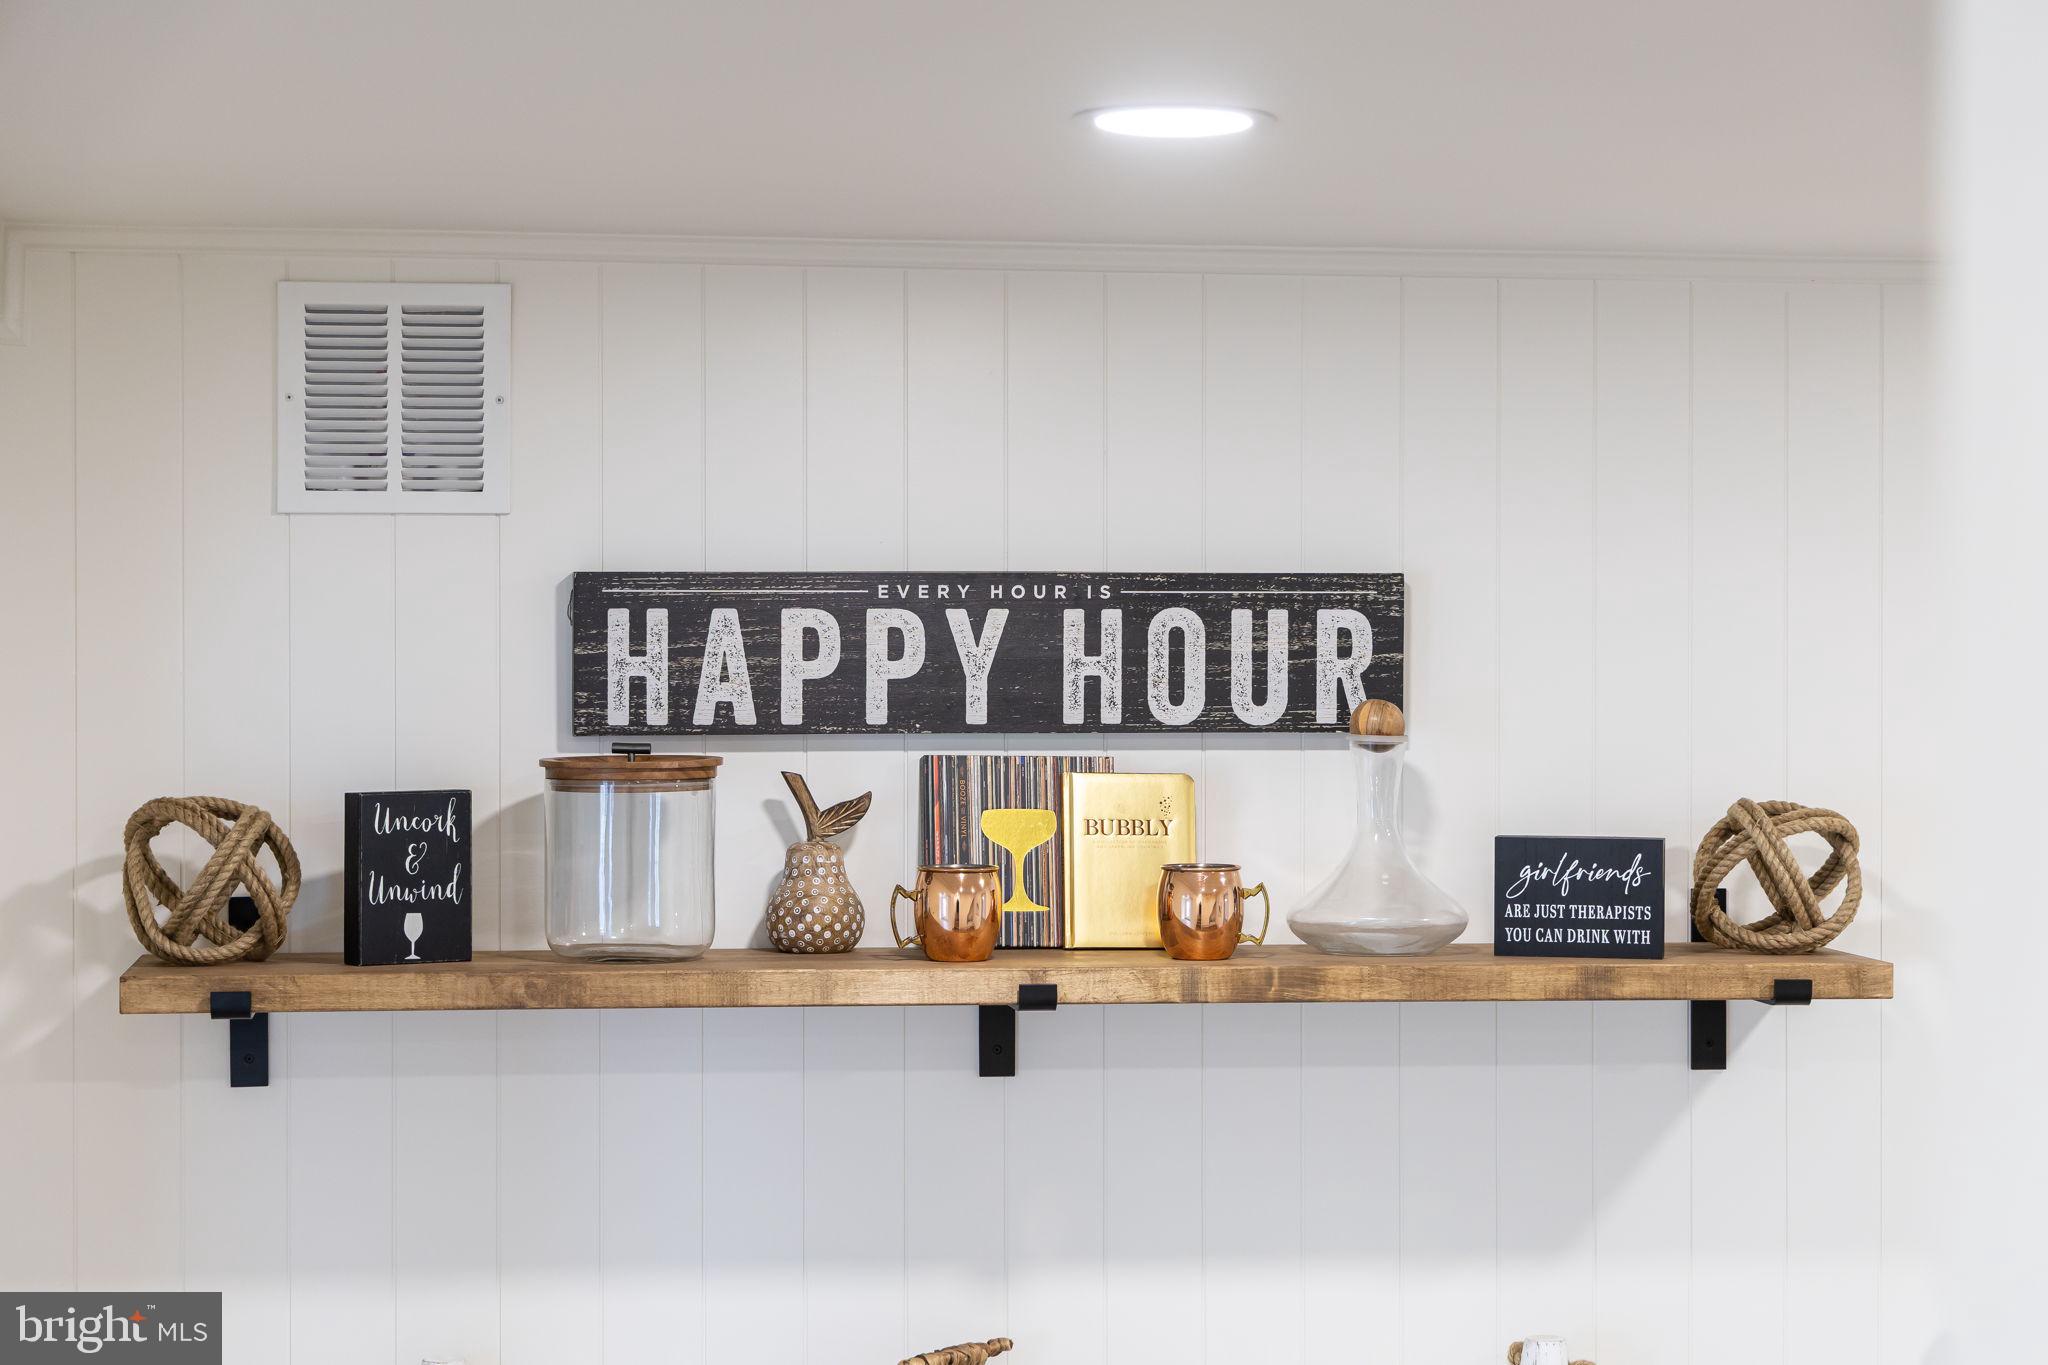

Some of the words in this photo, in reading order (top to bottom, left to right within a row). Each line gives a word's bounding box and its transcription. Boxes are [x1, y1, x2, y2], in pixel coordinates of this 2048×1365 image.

[877, 584, 970, 599] EVERY
[990, 584, 1067, 600] HOUR
[1087, 584, 1112, 600] IS
[606, 607, 1010, 727] HAPPY
[1062, 607, 1375, 727] HOUR
[959, 779, 967, 805] BOOZE
[374, 797, 461, 843] Uncork
[1084, 819, 1174, 836] BUBBLY
[404, 841, 429, 875] &
[368, 862, 464, 906] Unwind
[1505, 852, 1652, 899] girlfriends
[1504, 903, 1531, 918] ARE
[1533, 904, 1566, 919] JUST
[1568, 904, 1652, 921] THERAPISTS
[1504, 927, 1532, 943] YOU
[1535, 928, 1563, 943] CAN
[1566, 928, 1610, 944] DRINK
[1613, 929, 1651, 945] WITH
